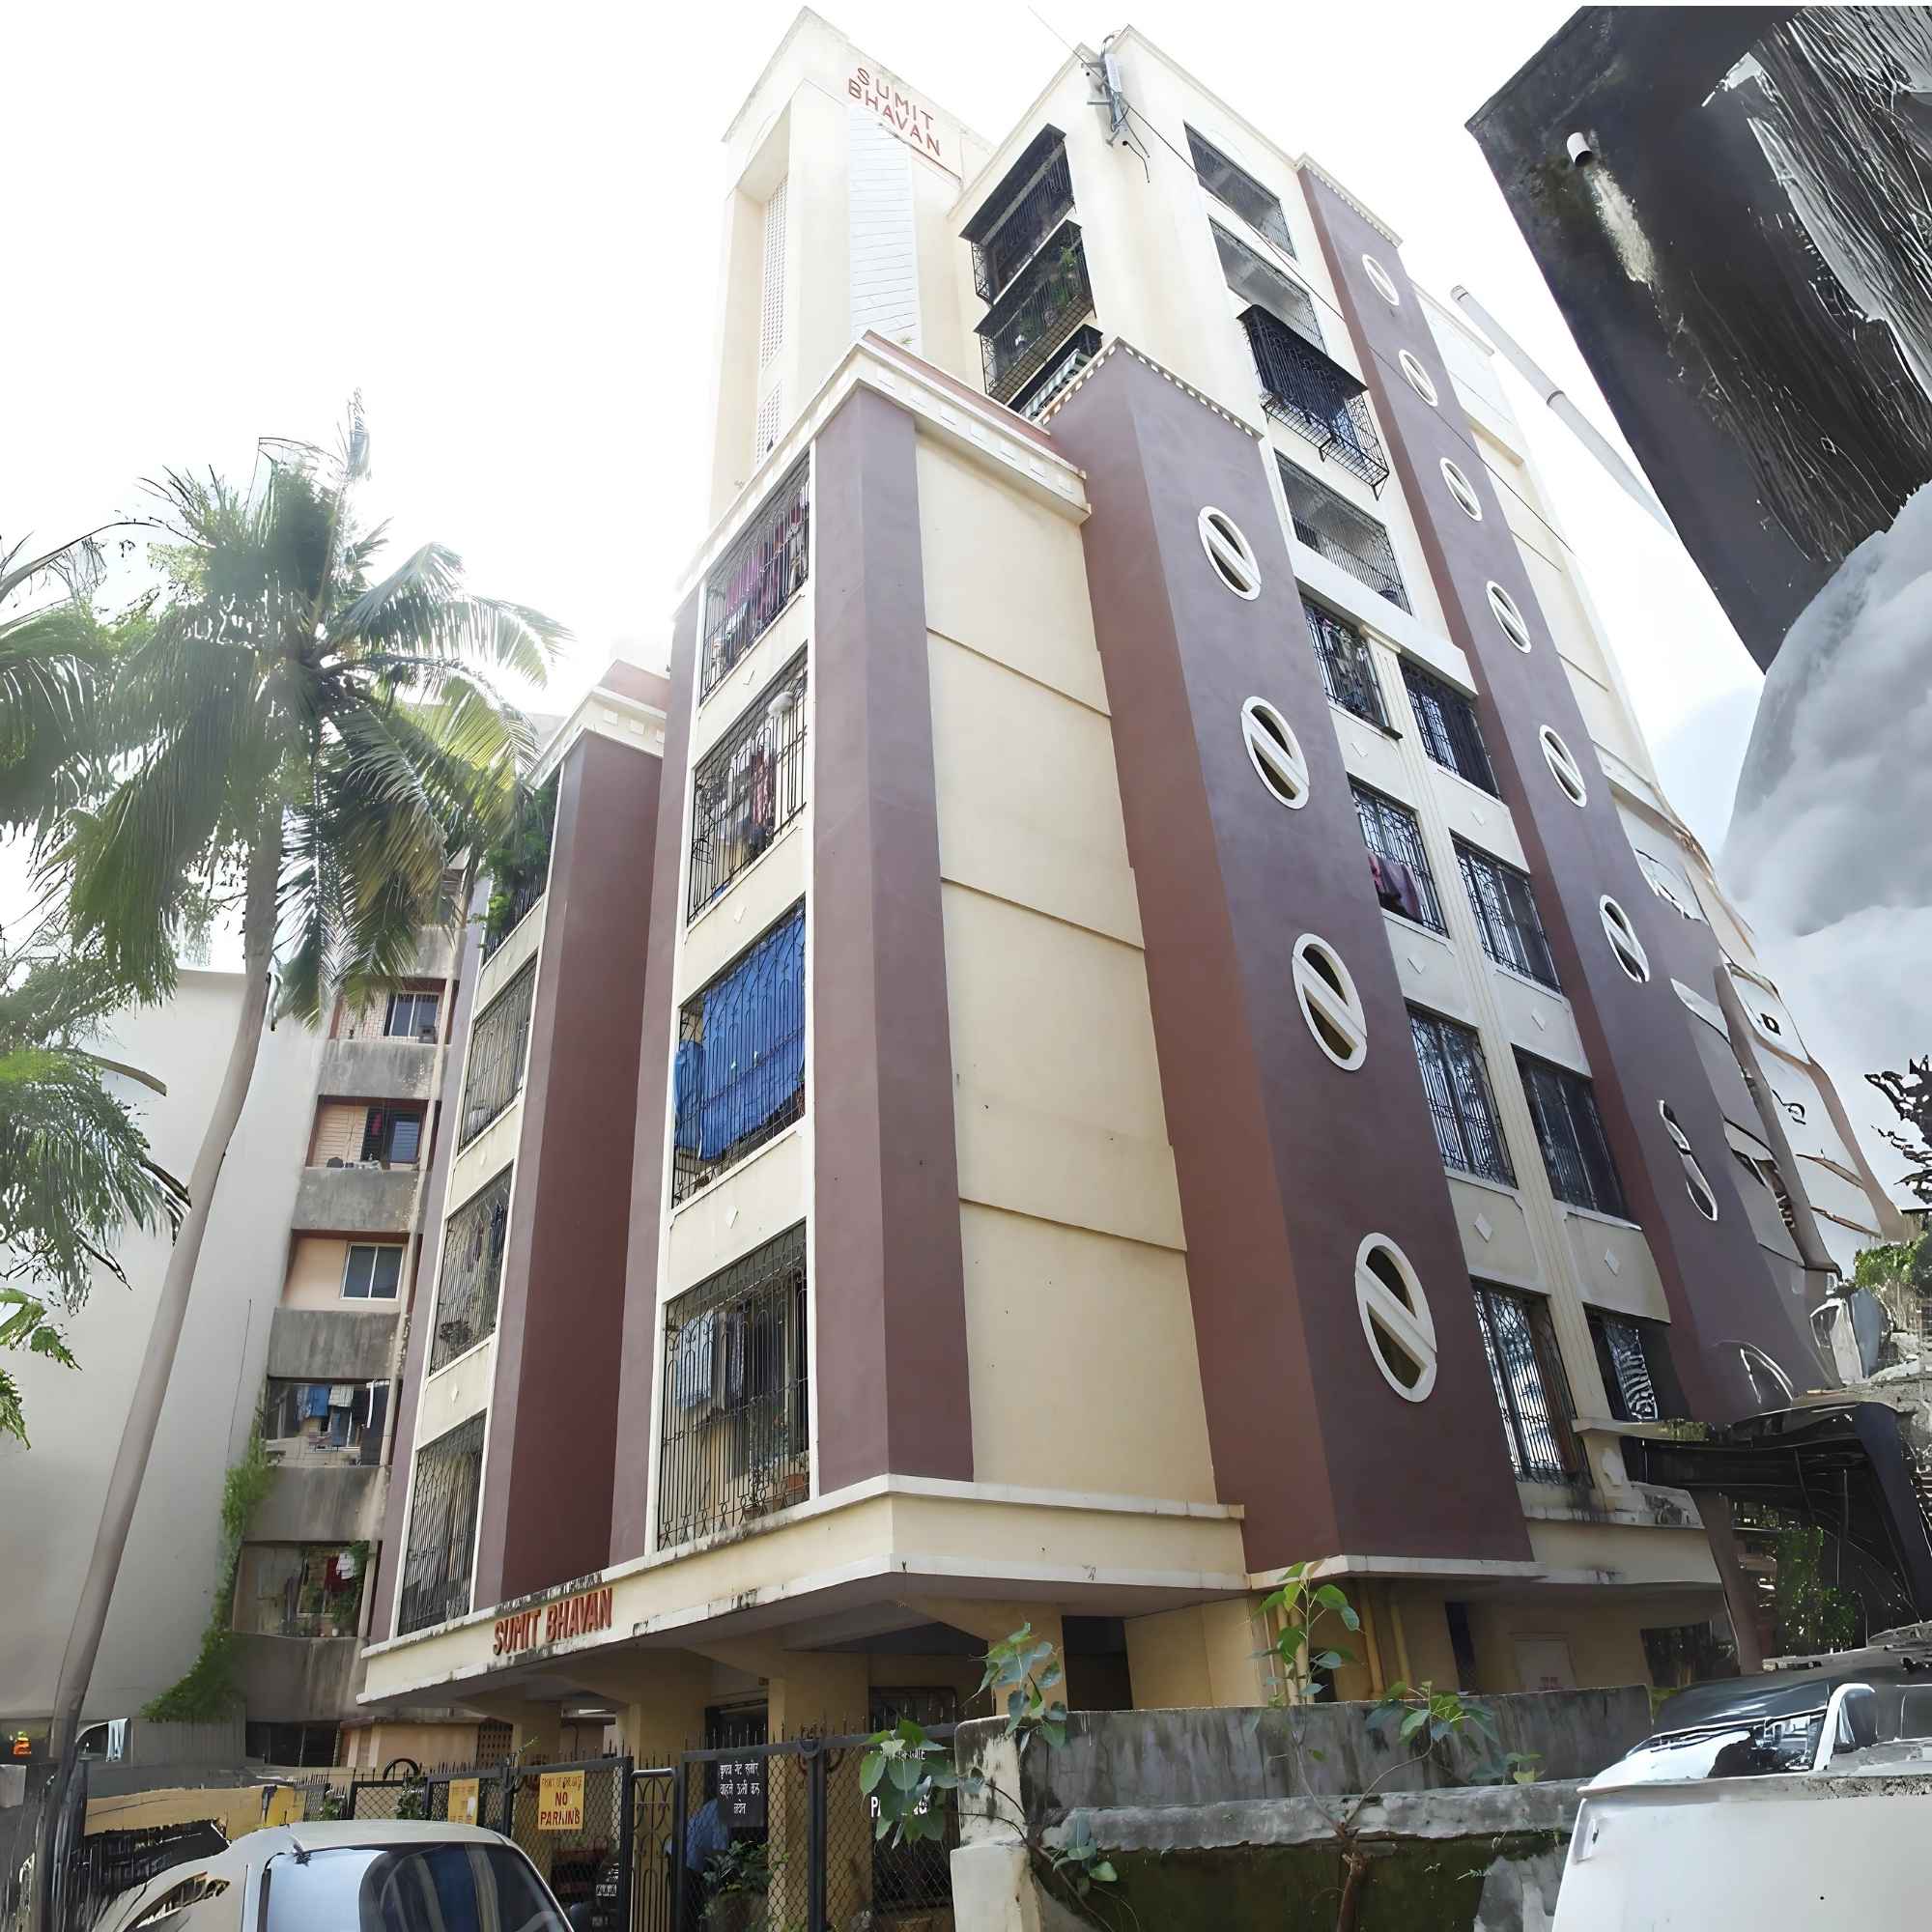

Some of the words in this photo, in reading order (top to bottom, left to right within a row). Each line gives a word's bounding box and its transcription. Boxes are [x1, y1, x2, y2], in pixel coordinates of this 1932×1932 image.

[849, 78, 941, 156] BHAVAN
[858, 68, 934, 129] SUMIT
[493, 1609, 541, 1656] SUMIT
[546, 1587, 612, 1643] BHAVAN
[554, 1792, 568, 1806] NO
